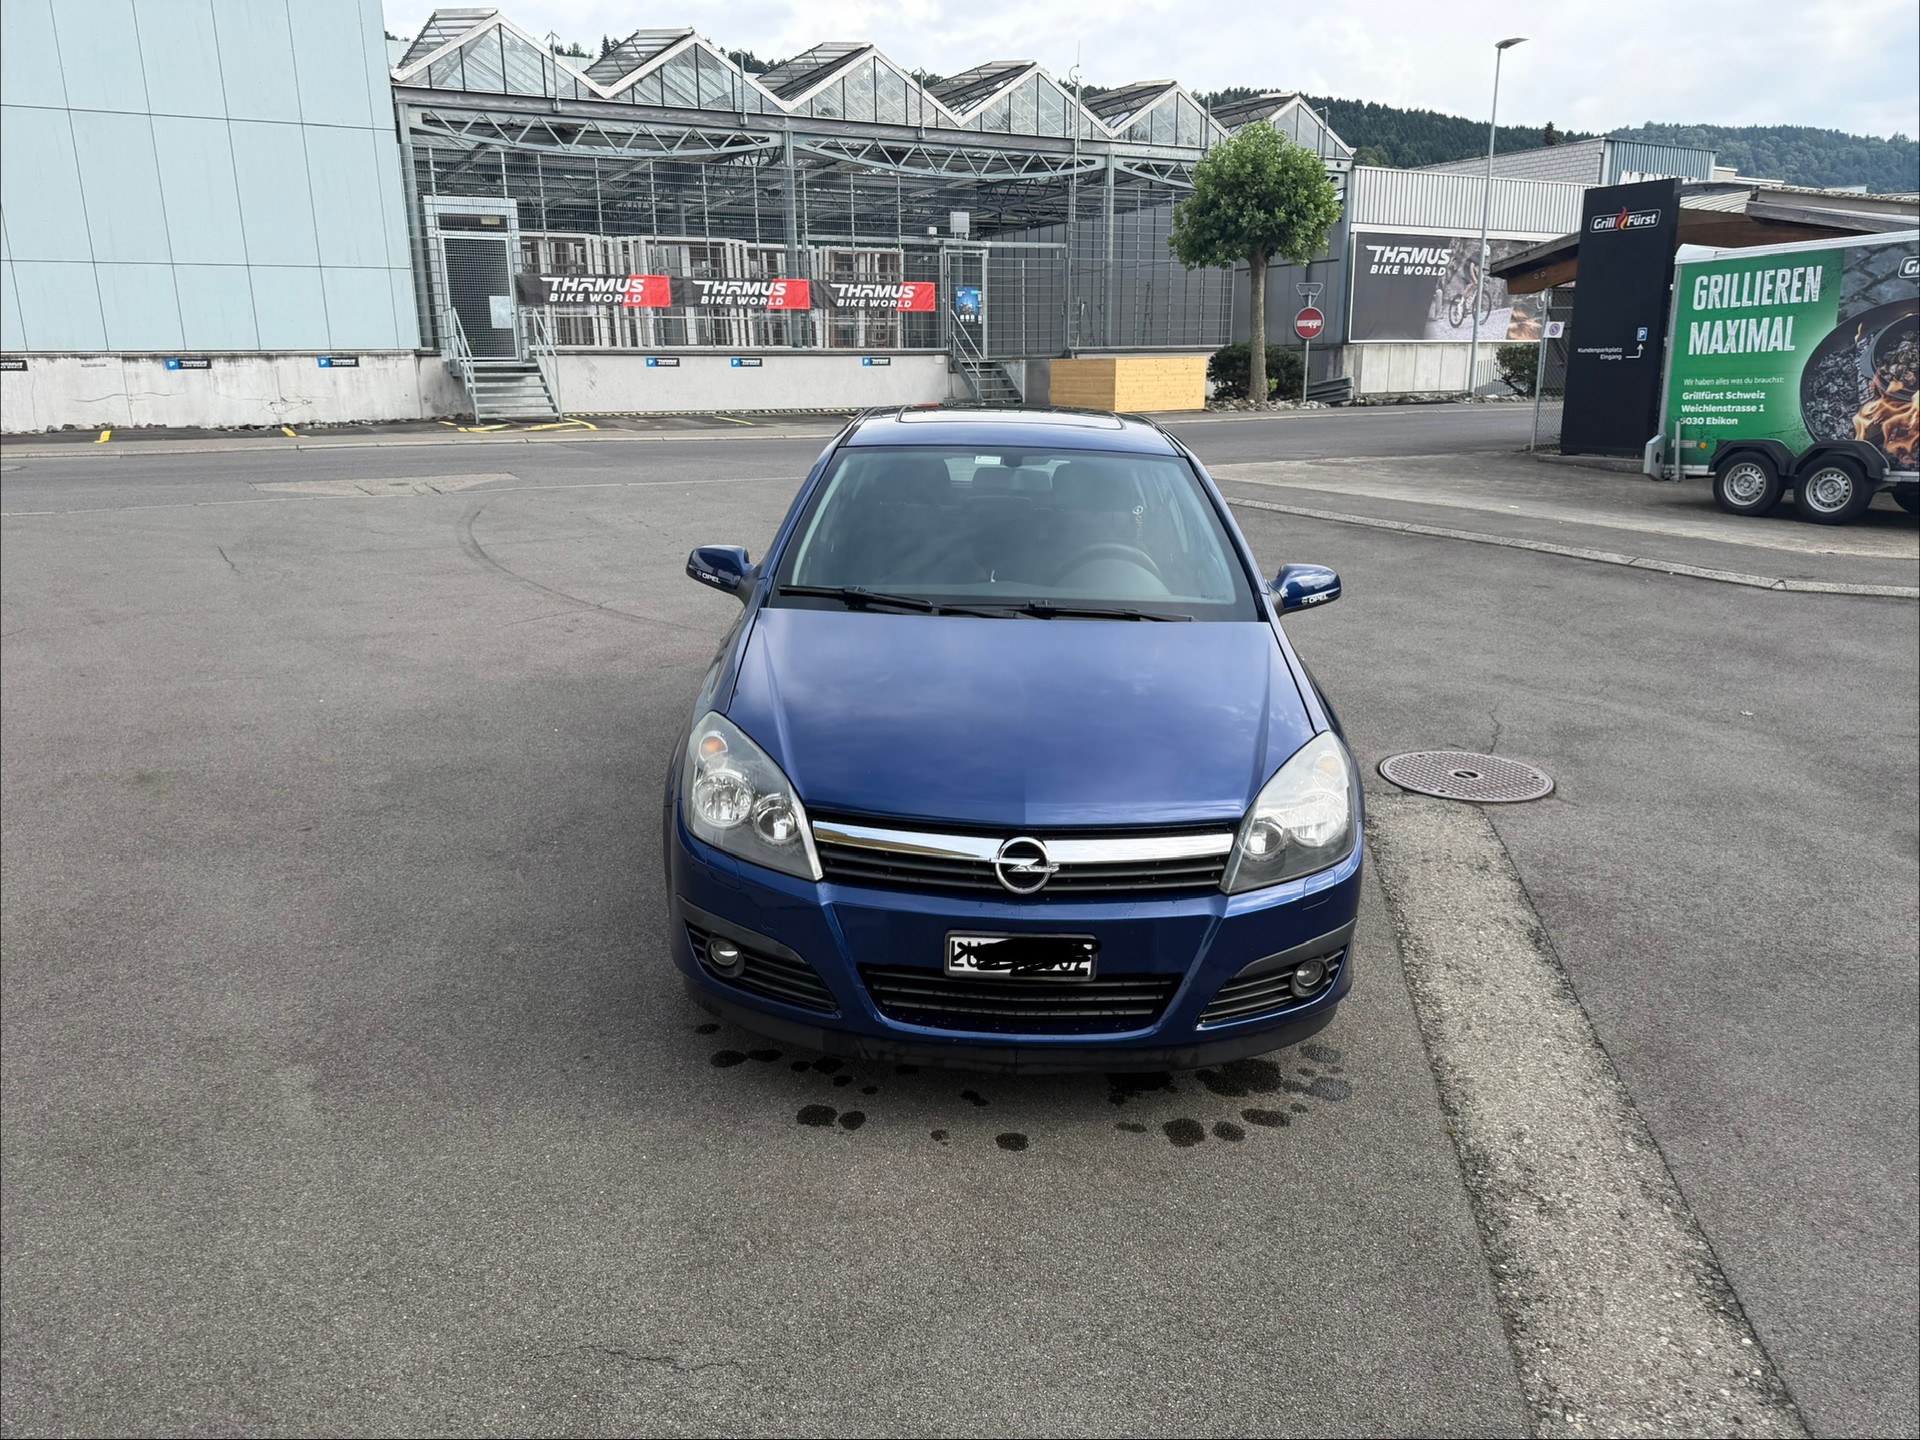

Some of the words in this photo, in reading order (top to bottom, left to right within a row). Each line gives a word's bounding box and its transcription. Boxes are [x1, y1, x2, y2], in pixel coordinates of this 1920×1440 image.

[1593, 217, 1616, 230] Grill
[1627, 214, 1657, 226] Fürst
[1369, 264, 1401, 275] BIKE
[1403, 265, 1447, 277] WORLD
[1692, 265, 1823, 311] GRILLIEREN
[549, 293, 585, 302] BIKE
[589, 293, 643, 303] WORLD
[700, 295, 734, 305] BIKE
[736, 295, 785, 306] WORLD
[836, 298, 867, 308] BIKE
[869, 299, 913, 308] WORLD
[1688, 315, 1796, 356] MAXIMAL
[1754, 376, 1784, 384] brauchst:
[1682, 391, 1724, 400] Grillfürst
[1725, 390, 1766, 399] Schweiz
[1681, 404, 1757, 413] Weichlenstrasse
[1758, 404, 1765, 412] 1
[1706, 416, 1738, 425] Ebikon
[702, 573, 720, 583] OPEL
[1309, 594, 1328, 603] OPEL
